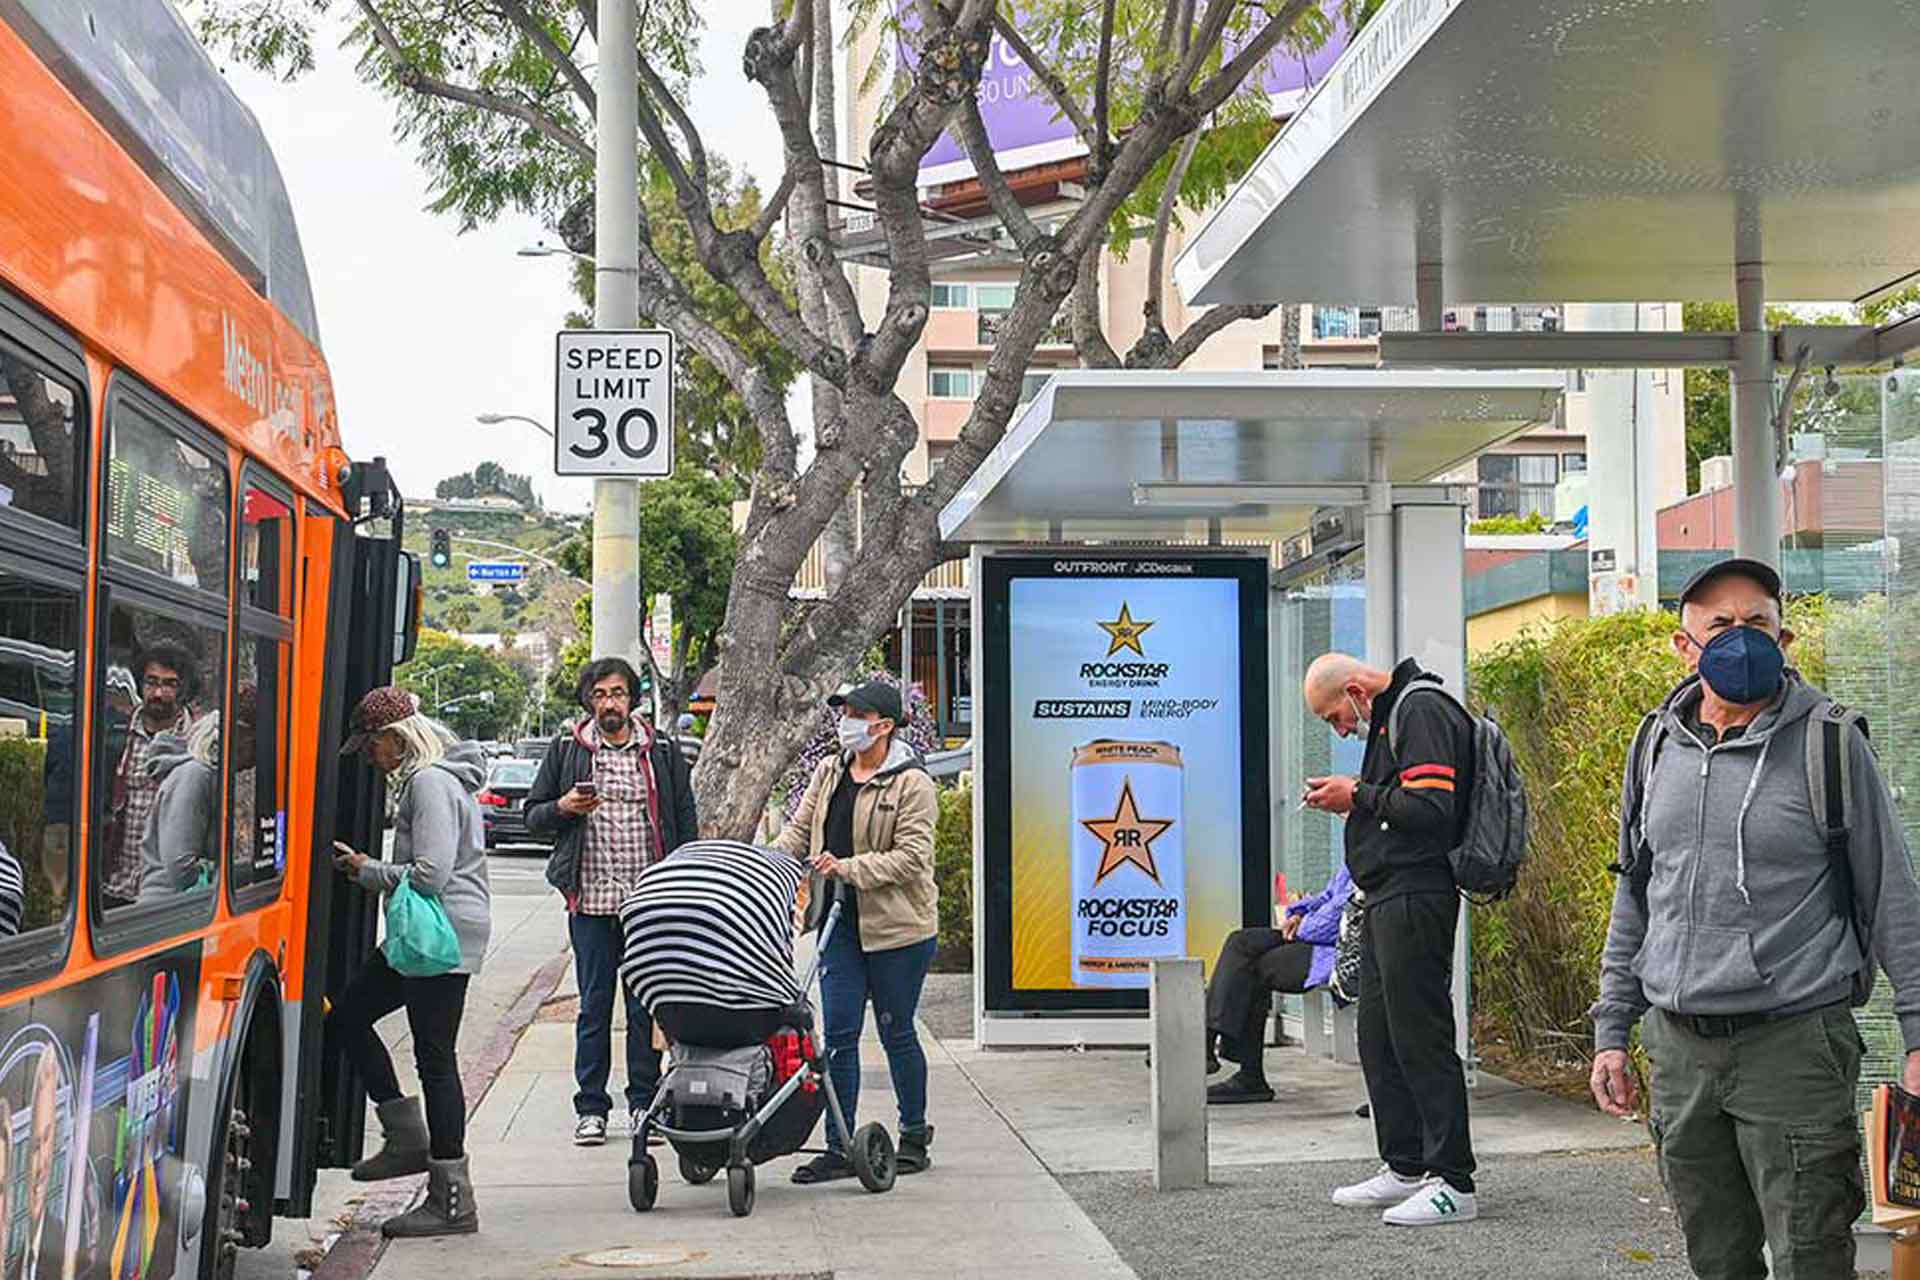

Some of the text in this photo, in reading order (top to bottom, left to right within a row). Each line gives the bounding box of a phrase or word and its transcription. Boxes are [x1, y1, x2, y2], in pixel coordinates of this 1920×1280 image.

[566, 348, 663, 369] SPEED
[576, 378, 651, 399] LIMIT
[569, 408, 658, 459] 30
[1053, 561, 1128, 573] OUTFRONT
[1080, 663, 1169, 678] ROCKSTAR
[1089, 679, 1160, 688] ENERGY DRINK
[1037, 703, 1129, 716] SUSTAINS
[1142, 699, 1219, 710] MIND-BODY
[1140, 710, 1192, 718] ENERGY
[1078, 899, 1178, 918] ROCKSTAR
[1088, 920, 1169, 936] FOCUS
